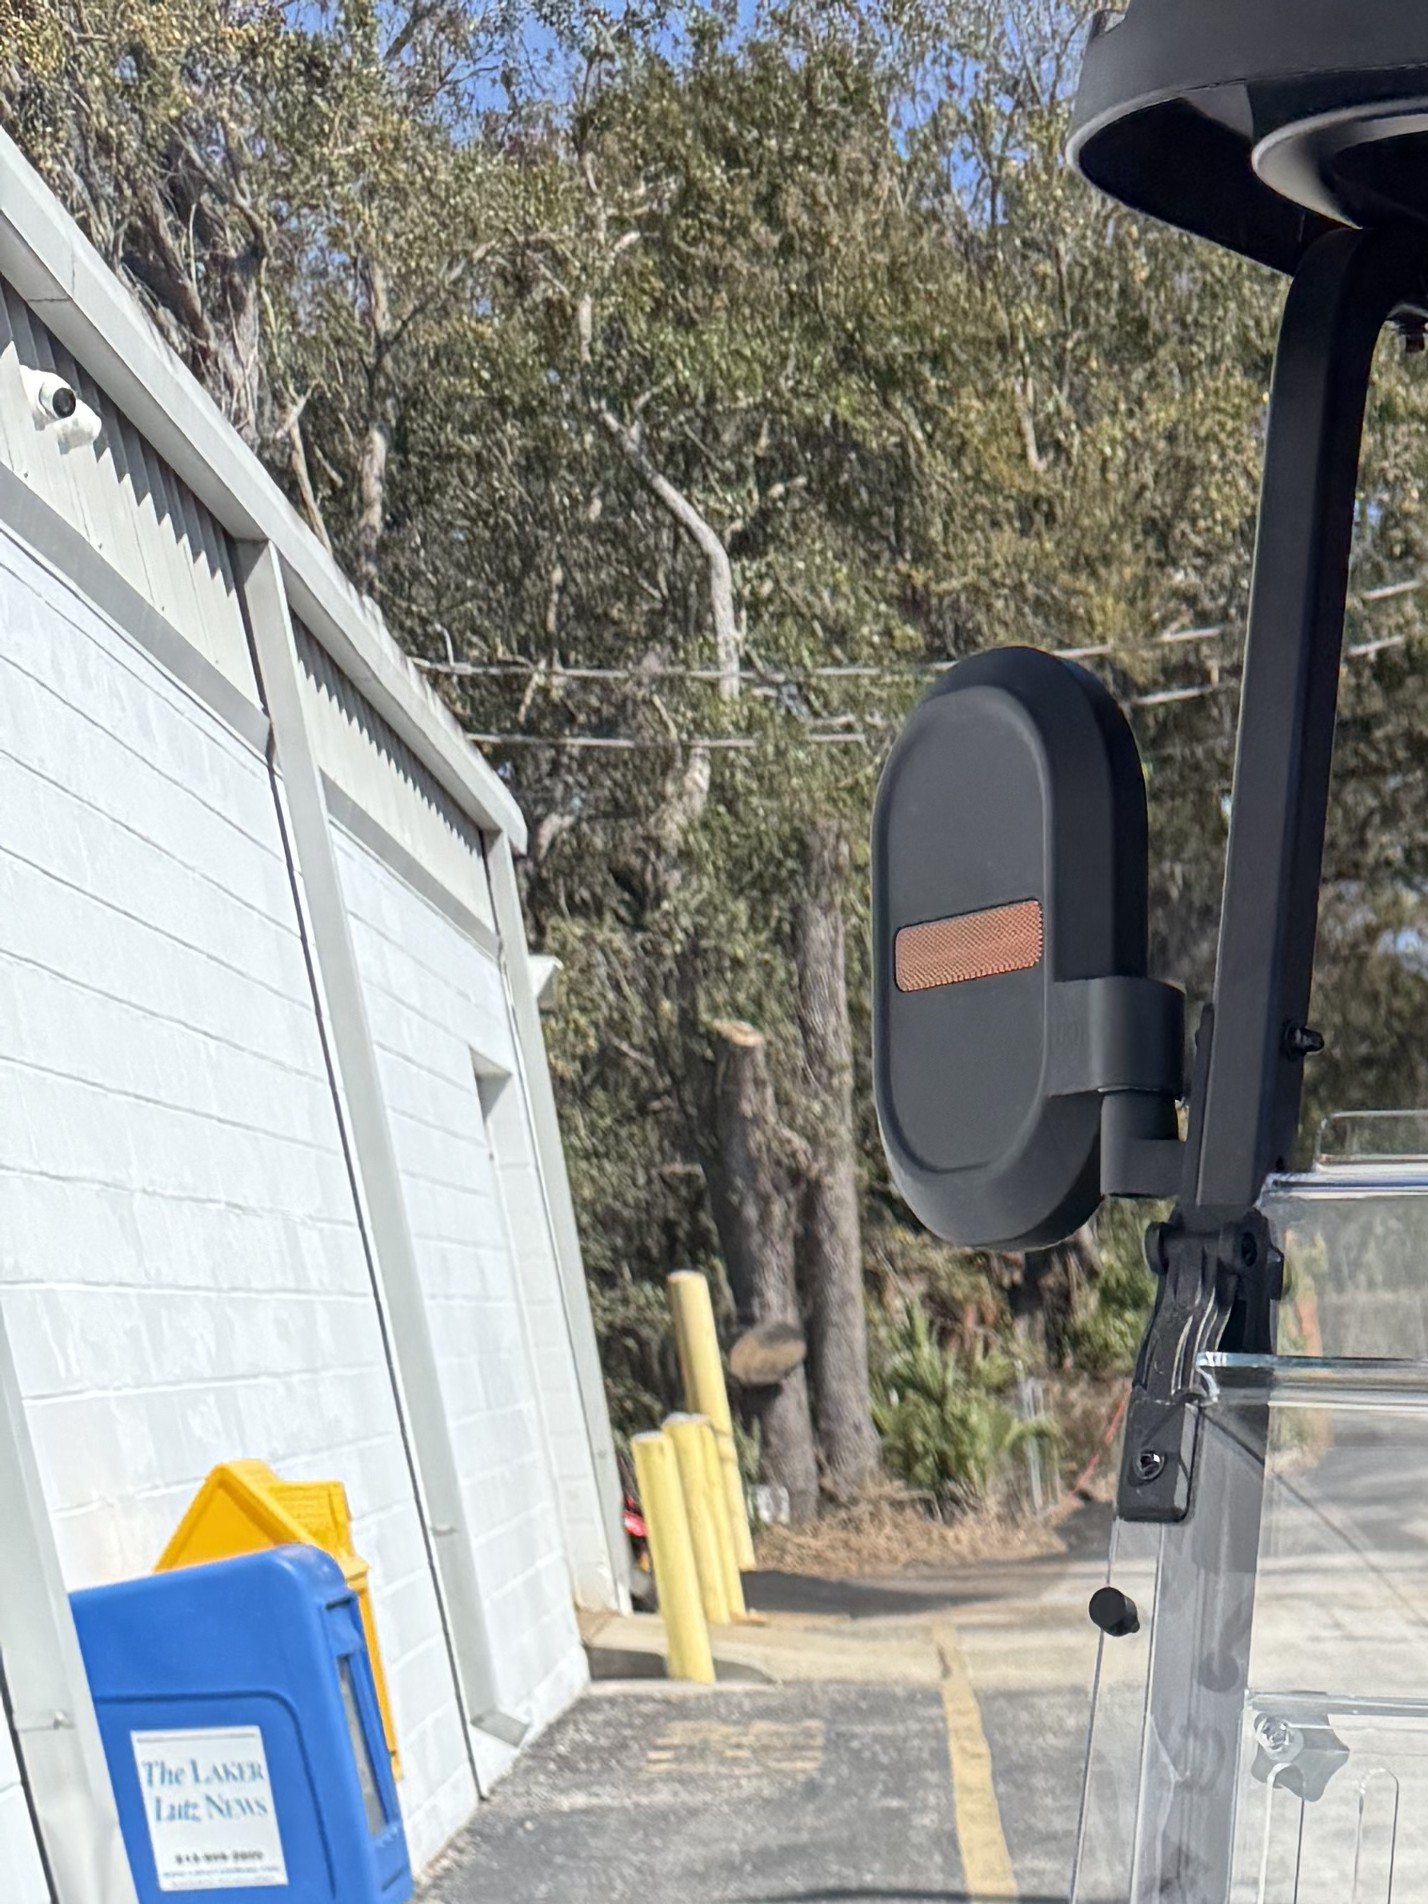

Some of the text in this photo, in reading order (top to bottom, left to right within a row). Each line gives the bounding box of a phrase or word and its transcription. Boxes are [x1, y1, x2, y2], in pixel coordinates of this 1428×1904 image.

[142, 1757, 265, 1788] The LAKER
[204, 1793, 268, 1820] NEWS
